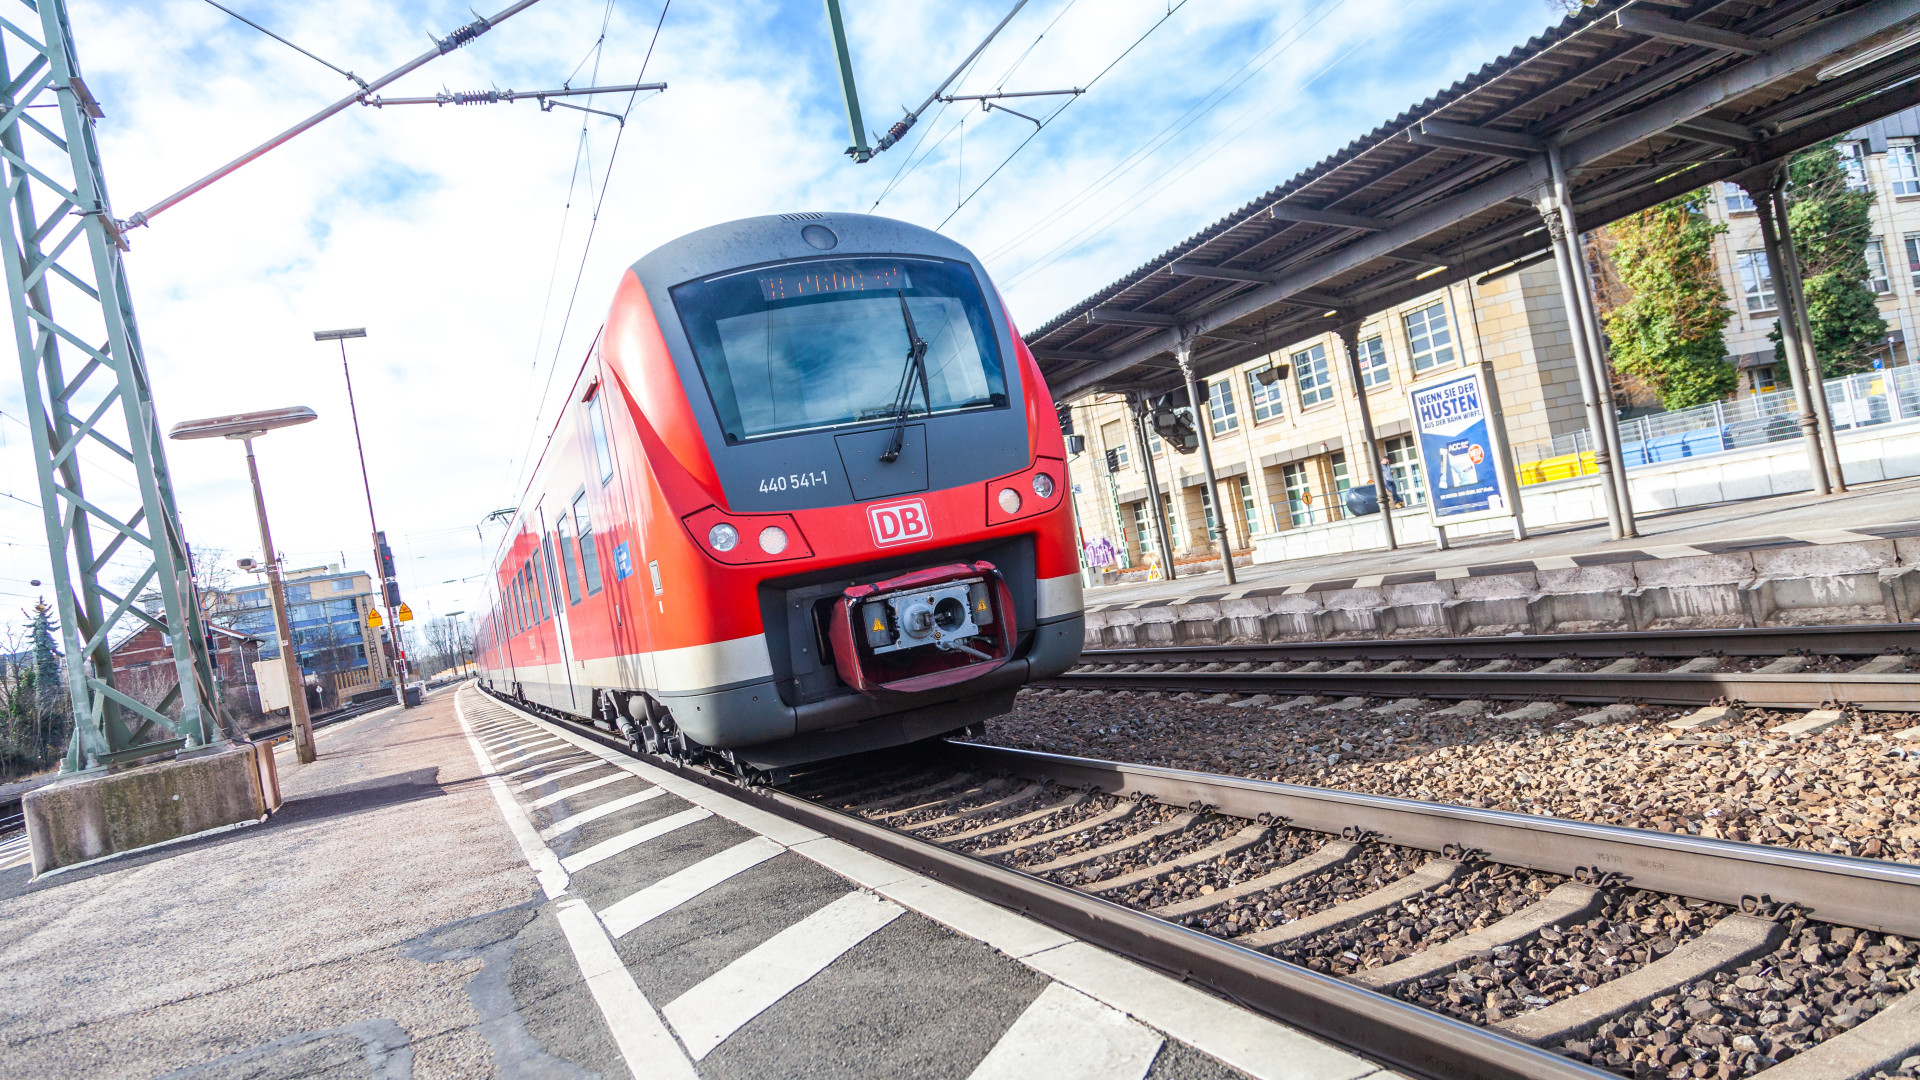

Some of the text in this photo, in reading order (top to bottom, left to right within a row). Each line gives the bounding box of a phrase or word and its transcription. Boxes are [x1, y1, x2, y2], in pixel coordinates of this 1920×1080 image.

[1418, 382, 1475, 406] WENN SIE DER
[1420, 393, 1479, 422] HUSTEN
[1436, 418, 1447, 427] DER
[1447, 414, 1462, 424] BAHN
[1463, 409, 1482, 420] WIRFT.
[759, 470, 828, 494] 440 541-1
[874, 505, 925, 542] DB
